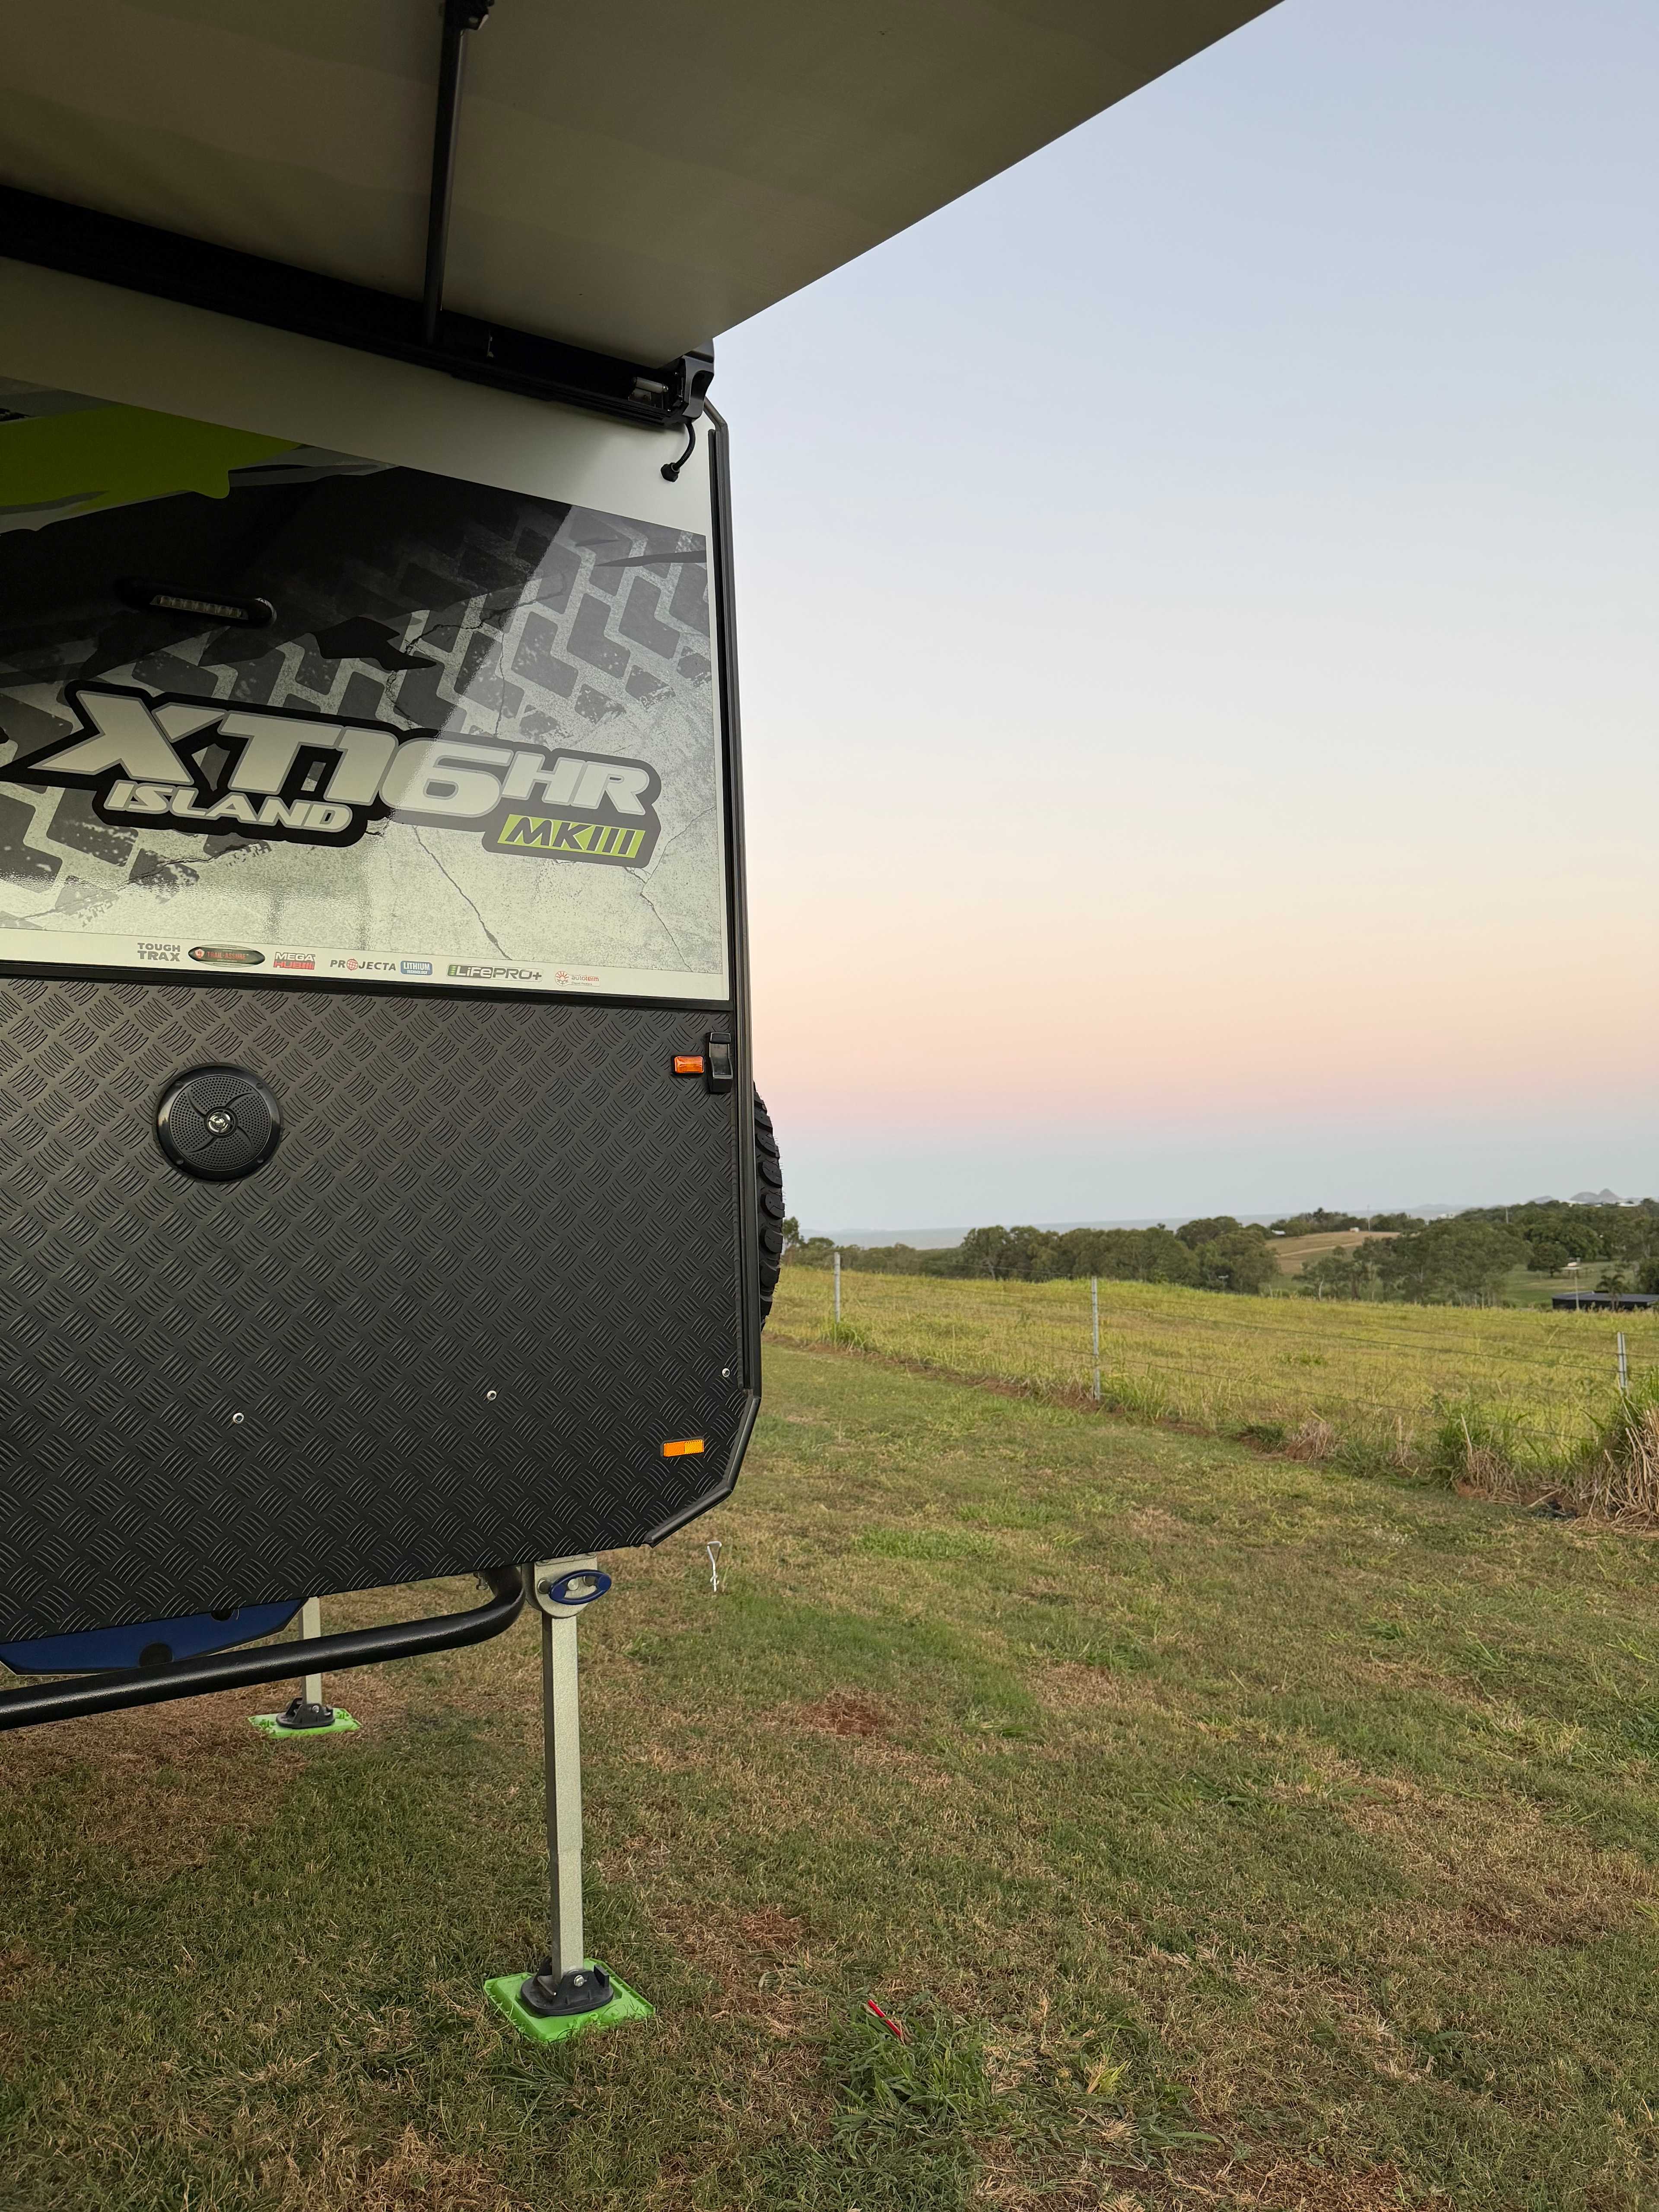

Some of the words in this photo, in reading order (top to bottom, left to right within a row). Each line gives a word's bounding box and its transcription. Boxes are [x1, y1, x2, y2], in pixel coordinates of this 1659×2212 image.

[104, 779, 353, 833] ISLAND
[505, 817, 636, 855] MKIII
[137, 943, 181, 952] TOUGH
[137, 950, 181, 962] TRAX
[275, 952, 315, 962] MEGA
[404, 962, 430, 970] LITHIUM
